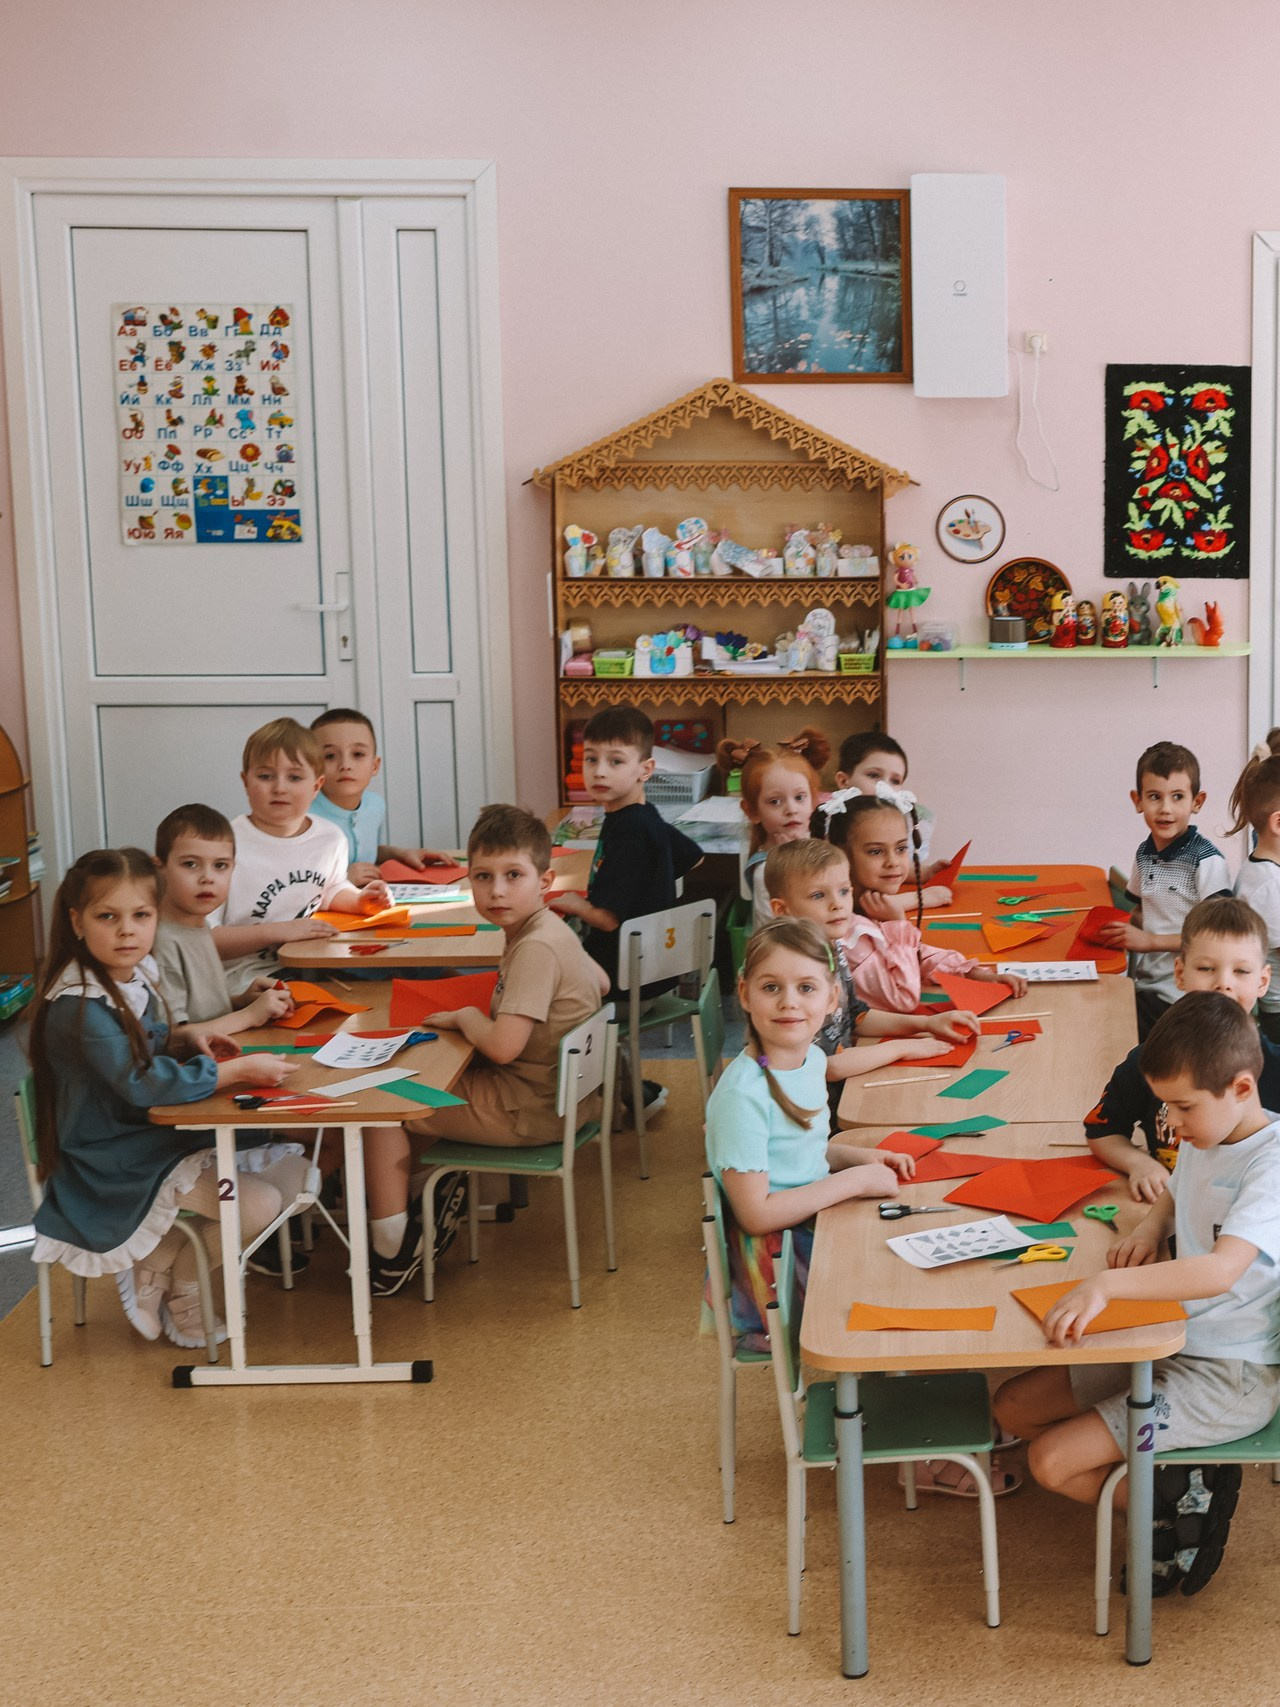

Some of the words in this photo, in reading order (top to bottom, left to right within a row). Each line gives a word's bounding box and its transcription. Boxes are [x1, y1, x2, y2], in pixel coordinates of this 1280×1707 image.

[189, 325, 209, 337] Вв
[260, 324, 282, 337] Дд
[190, 360, 215, 371] Жж
[157, 460, 184, 473] Фф
[250, 878, 286, 919] KAPPA
[665, 927, 676, 949] 3
[585, 1033, 592, 1056] 2
[217, 1178, 235, 1201] 2
[1136, 1423, 1154, 1452] 2
